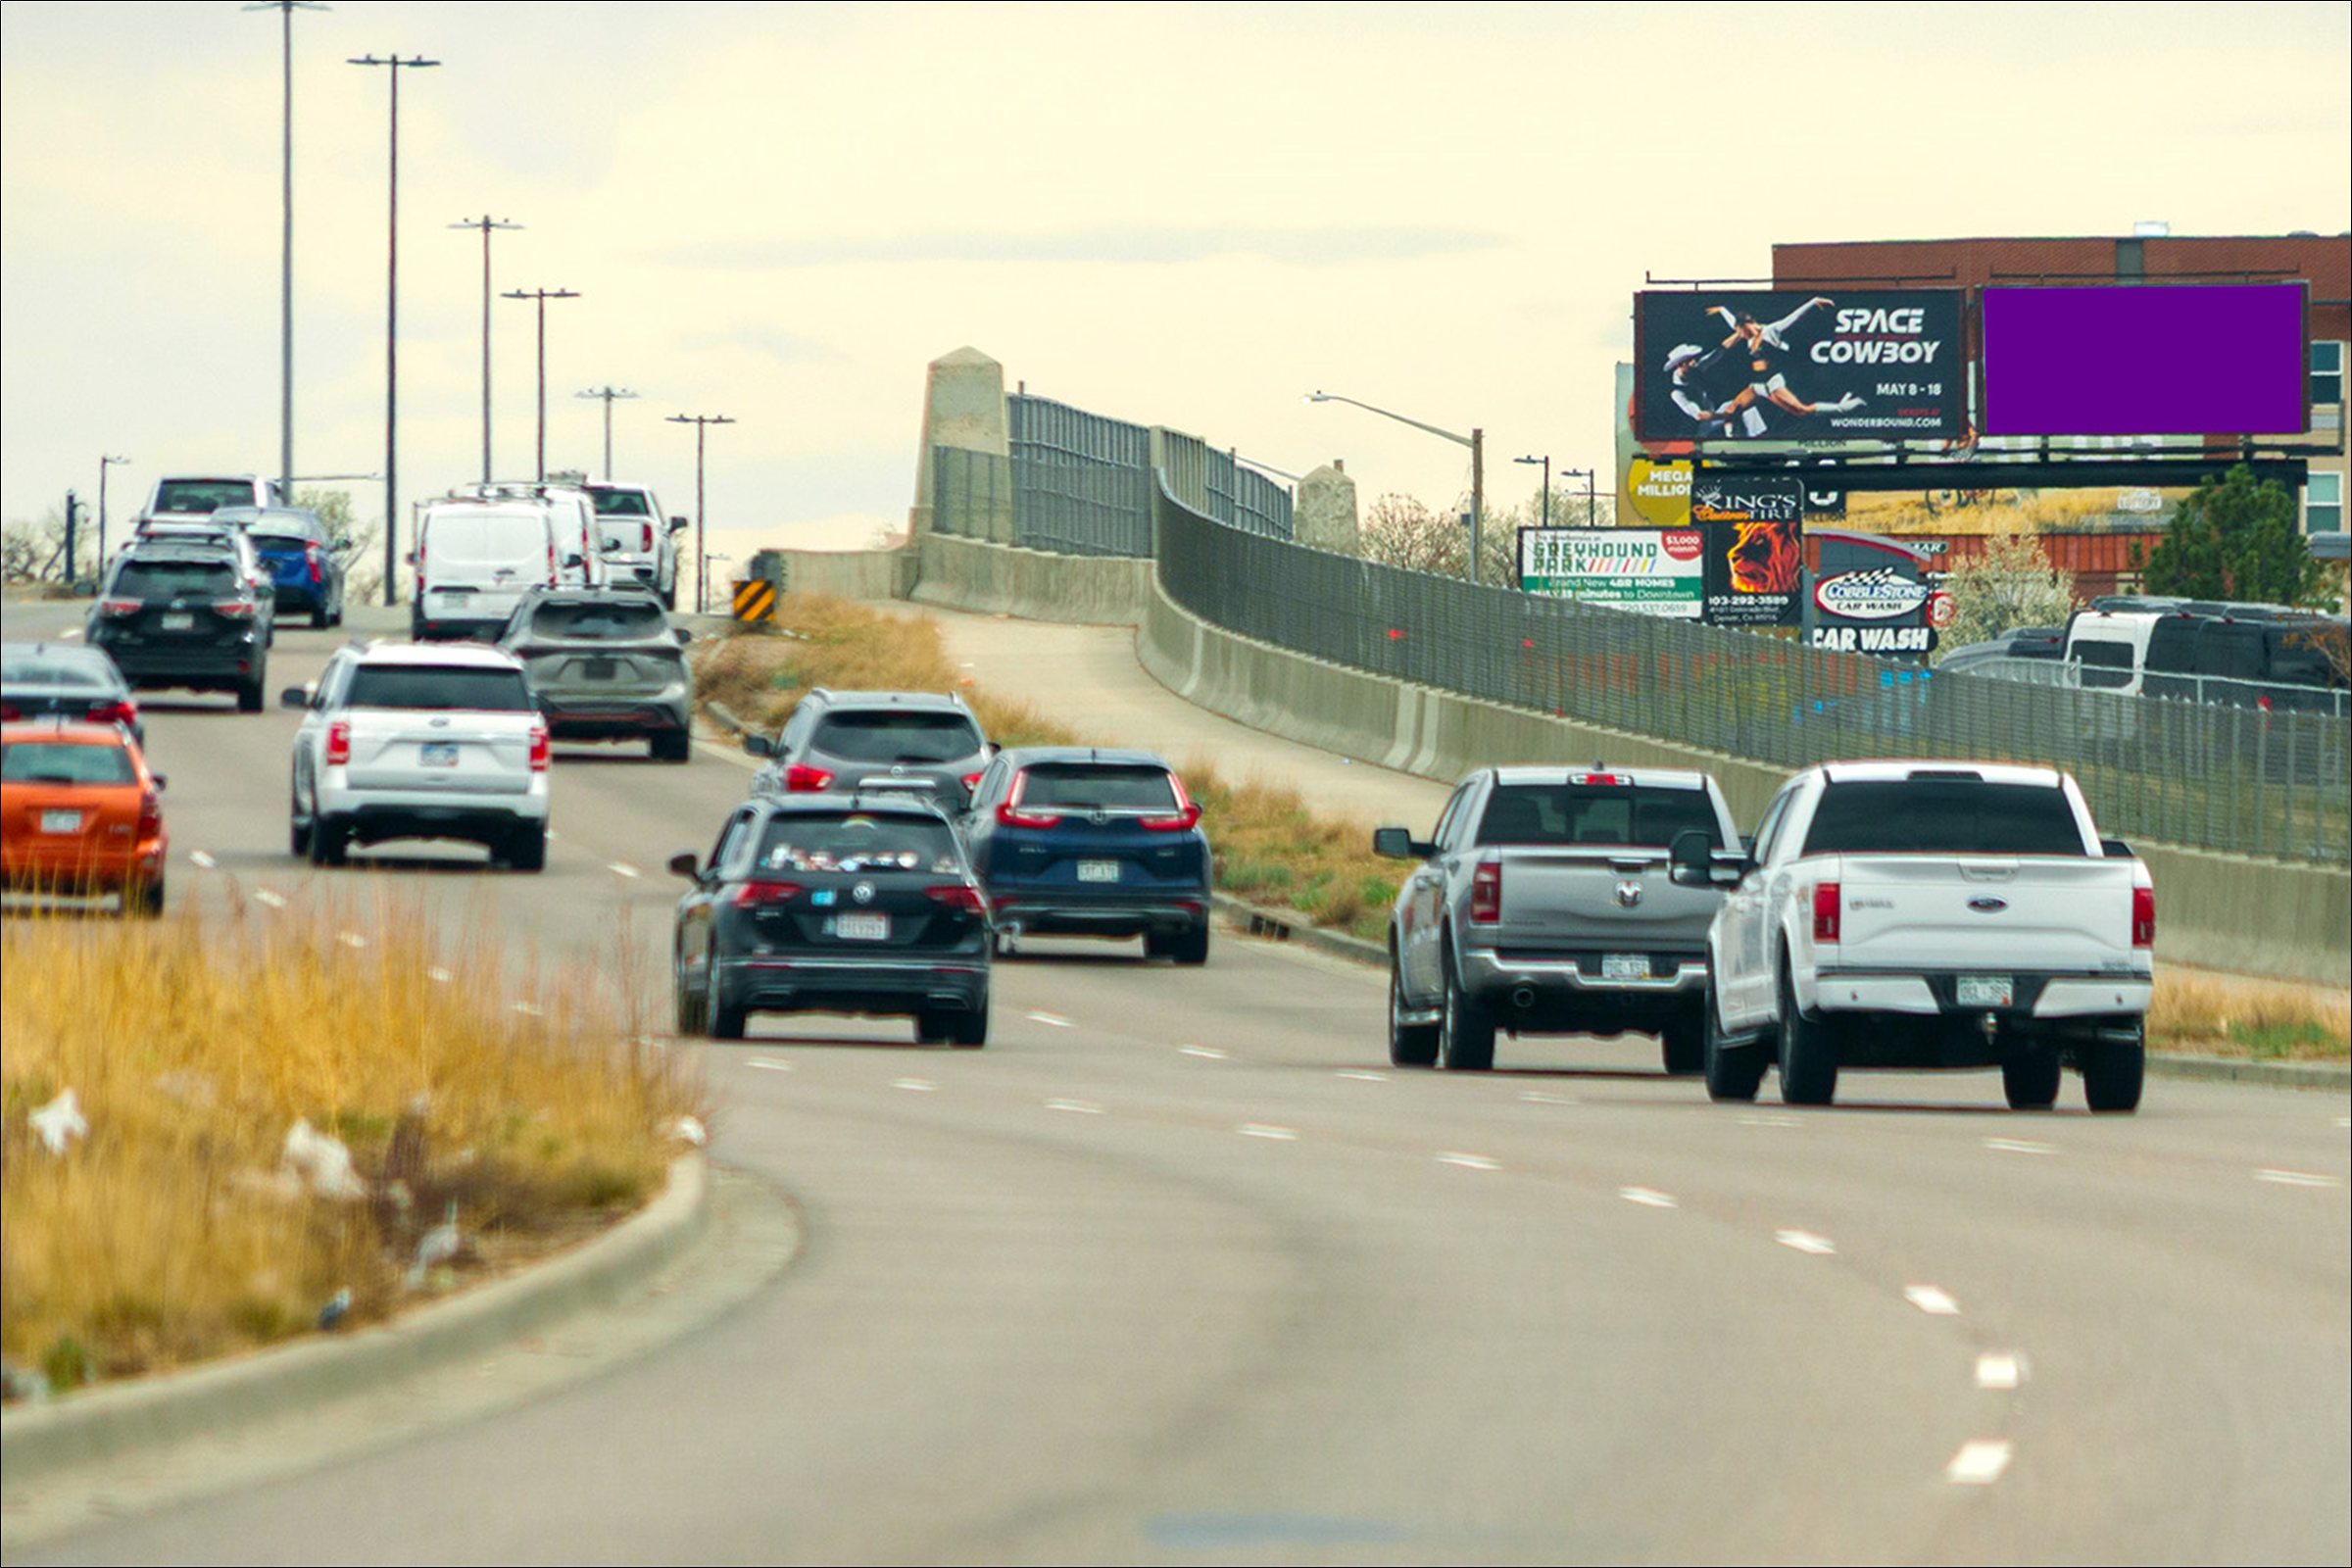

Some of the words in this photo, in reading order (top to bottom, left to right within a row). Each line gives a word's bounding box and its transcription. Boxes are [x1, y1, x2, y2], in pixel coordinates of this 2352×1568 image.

[1835, 308, 1925, 333] SPACE
[1810, 340, 1940, 364] COWBOY
[1876, 382, 1907, 395] MAY
[1908, 382, 1918, 395] 8
[1928, 382, 1941, 395] 18
[1830, 416, 1942, 428] WONDERBOUND.COM
[1650, 470, 1693, 482] MEGA
[1704, 493, 1797, 511] KING'S
[1749, 510, 1794, 520] TIRE
[1534, 542, 1658, 558] GREYHOUND
[1534, 558, 1587, 572] PARK
[1636, 578, 1677, 588] HOMES
[1637, 589, 1694, 599] Downtown
[1826, 582, 1928, 600] COBBLESTONE
[1837, 602, 1861, 611] CAR
[1866, 602, 1901, 611] WASH
[1813, 628, 1857, 651] CAR
[1860, 628, 1930, 651] WASH
